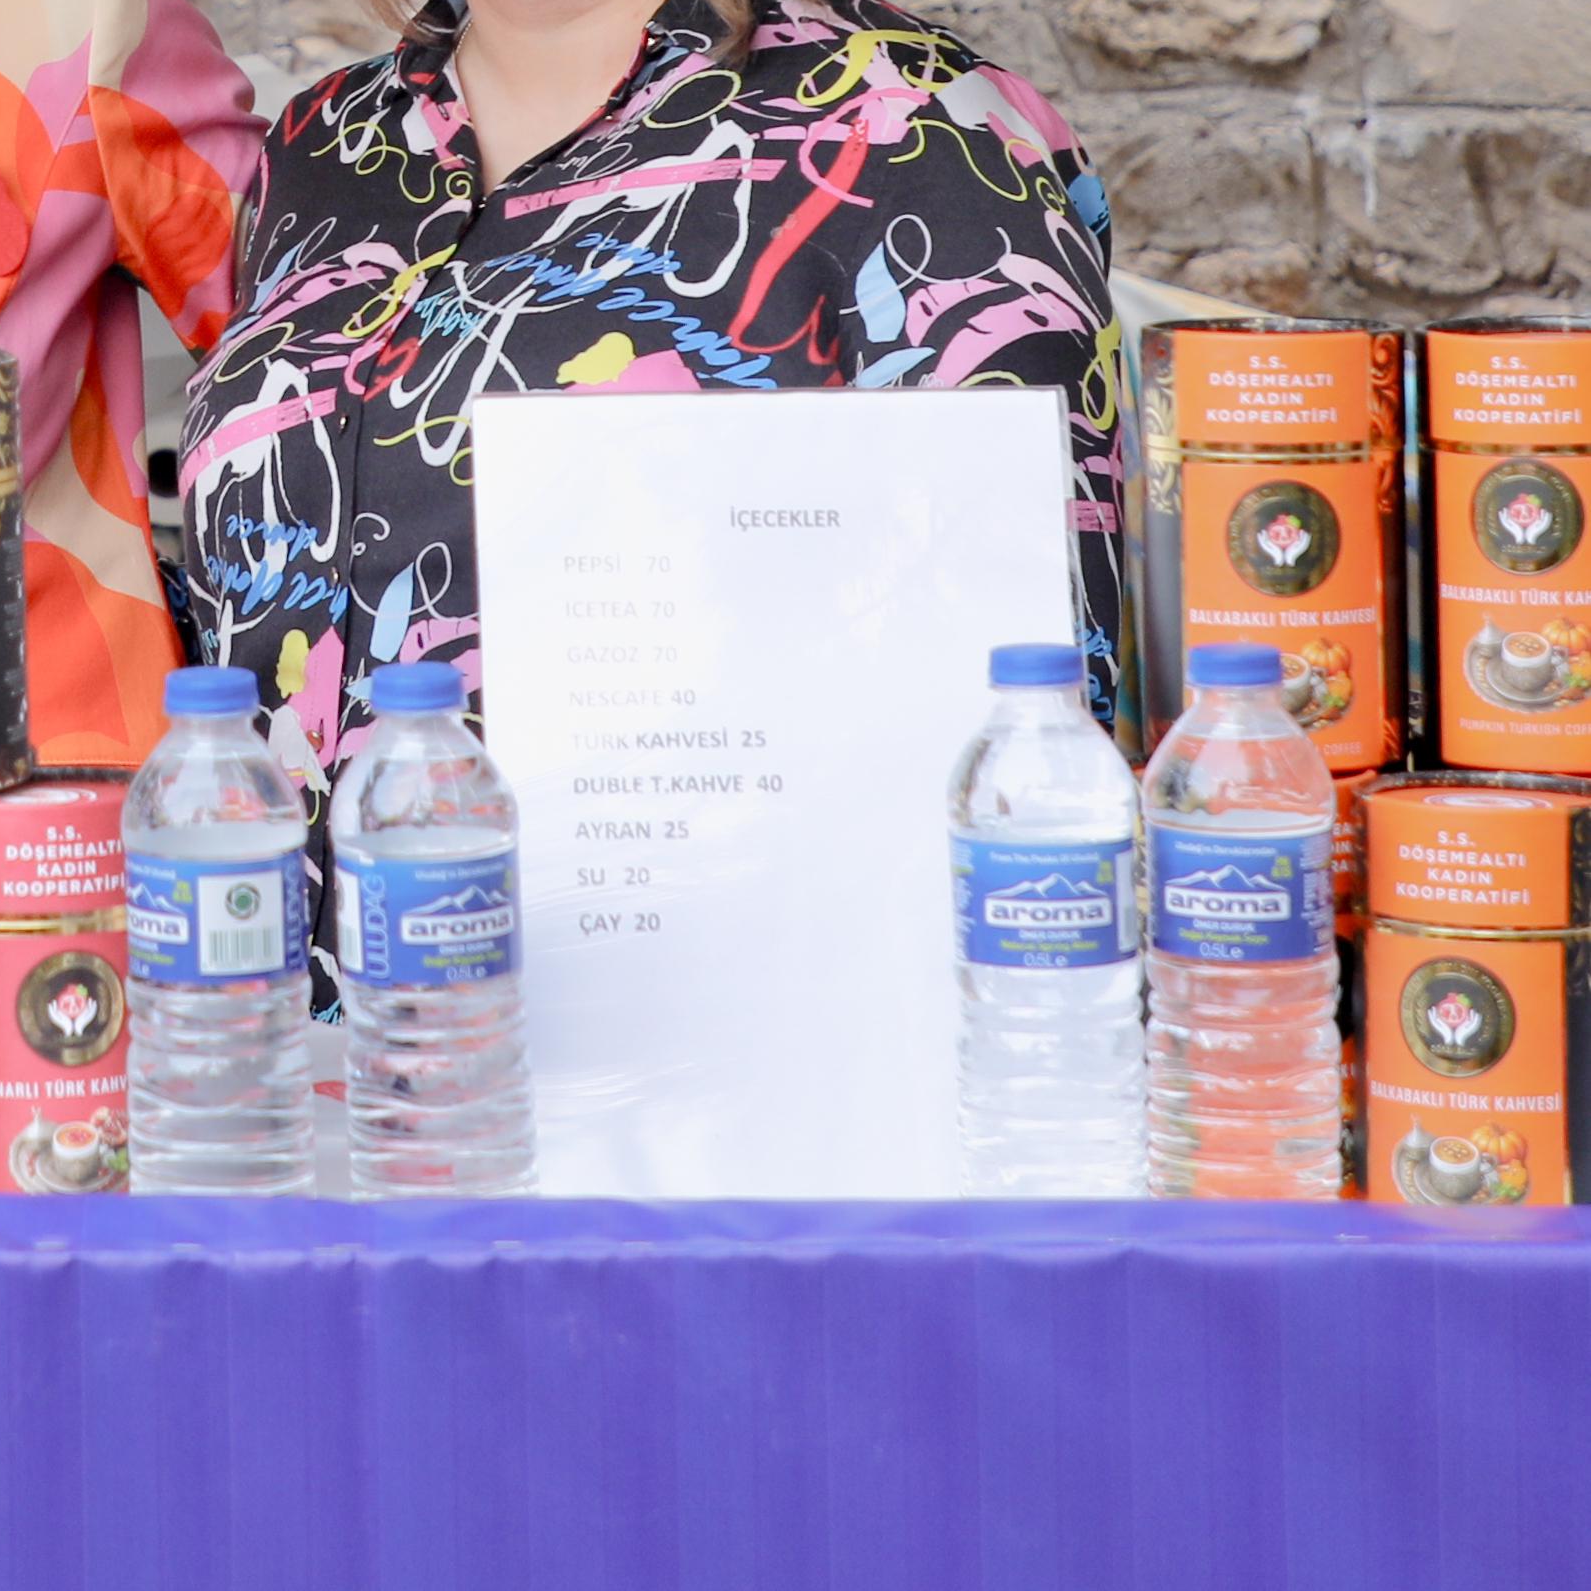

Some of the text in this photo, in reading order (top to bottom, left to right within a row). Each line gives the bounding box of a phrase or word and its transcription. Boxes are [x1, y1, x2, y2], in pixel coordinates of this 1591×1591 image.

[1209, 371, 1334, 387] DÖŞEMEALTI
[1456, 371, 1577, 388] DÖŞEMEALTI
[1239, 392, 1304, 405] KADIN
[1482, 392, 1545, 406] KADIN
[1206, 407, 1338, 424] KOOPERATİFİ
[1453, 409, 1582, 424] KOOPERATİFİ
[729, 506, 840, 531] İÇECEKLER
[645, 554, 671, 573] 70
[1521, 588, 1559, 604] TÜRK
[651, 600, 676, 619] 70
[1280, 610, 1320, 627] TÜRK
[567, 647, 677, 664] GAZOZ 70
[670, 689, 697, 706] 40
[636, 726, 728, 749] KAHVESİ
[740, 730, 767, 749] 25
[650, 774, 744, 794] T.KAHVE
[756, 774, 784, 794] 40
[574, 821, 690, 840] AYRAN 25
[1399, 845, 1525, 867] DÖŞEMEALTI
[36, 860, 97, 877] KADIN
[576, 867, 651, 887] SU 20
[1427, 867, 1492, 885] KADIN
[1169, 891, 1281, 913] aroma
[1395, 882, 1530, 905] KOOPERATİFİ
[991, 904, 1104, 922] aroma
[408, 911, 510, 937] aroma
[579, 912, 661, 936] ÇAY 20
[45, 1079, 86, 1099] TÜRK
[90, 1075, 127, 1096] KAHV
[1449, 1091, 1488, 1110] TÜRK
[1495, 1091, 1561, 1112] KAHVESİ
